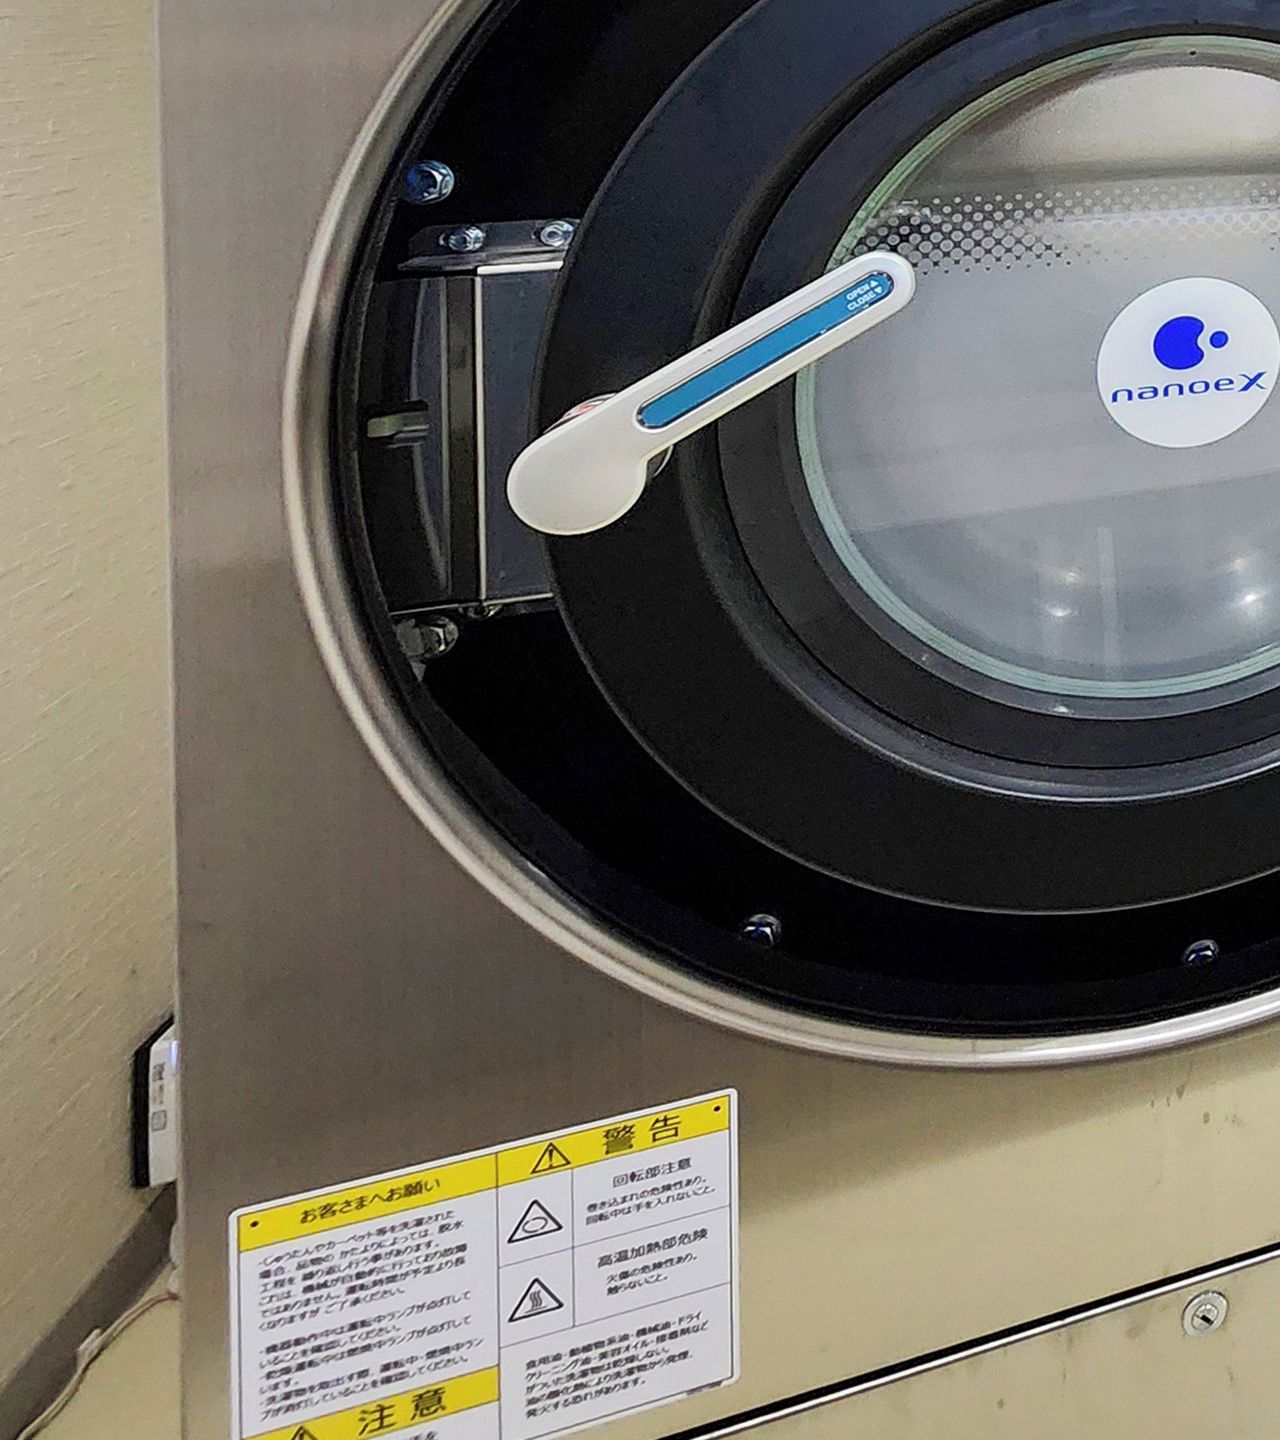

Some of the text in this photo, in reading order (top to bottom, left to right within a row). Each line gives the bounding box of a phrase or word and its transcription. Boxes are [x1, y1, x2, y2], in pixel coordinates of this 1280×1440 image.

[602, 1114, 682, 1156] 警告
[612, 1157, 692, 1189] 回転部注意
[300, 1176, 442, 1225] お客さまへお願い
[596, 1227, 709, 1269] 高温加熱部危険
[358, 1387, 447, 1436] 注意
